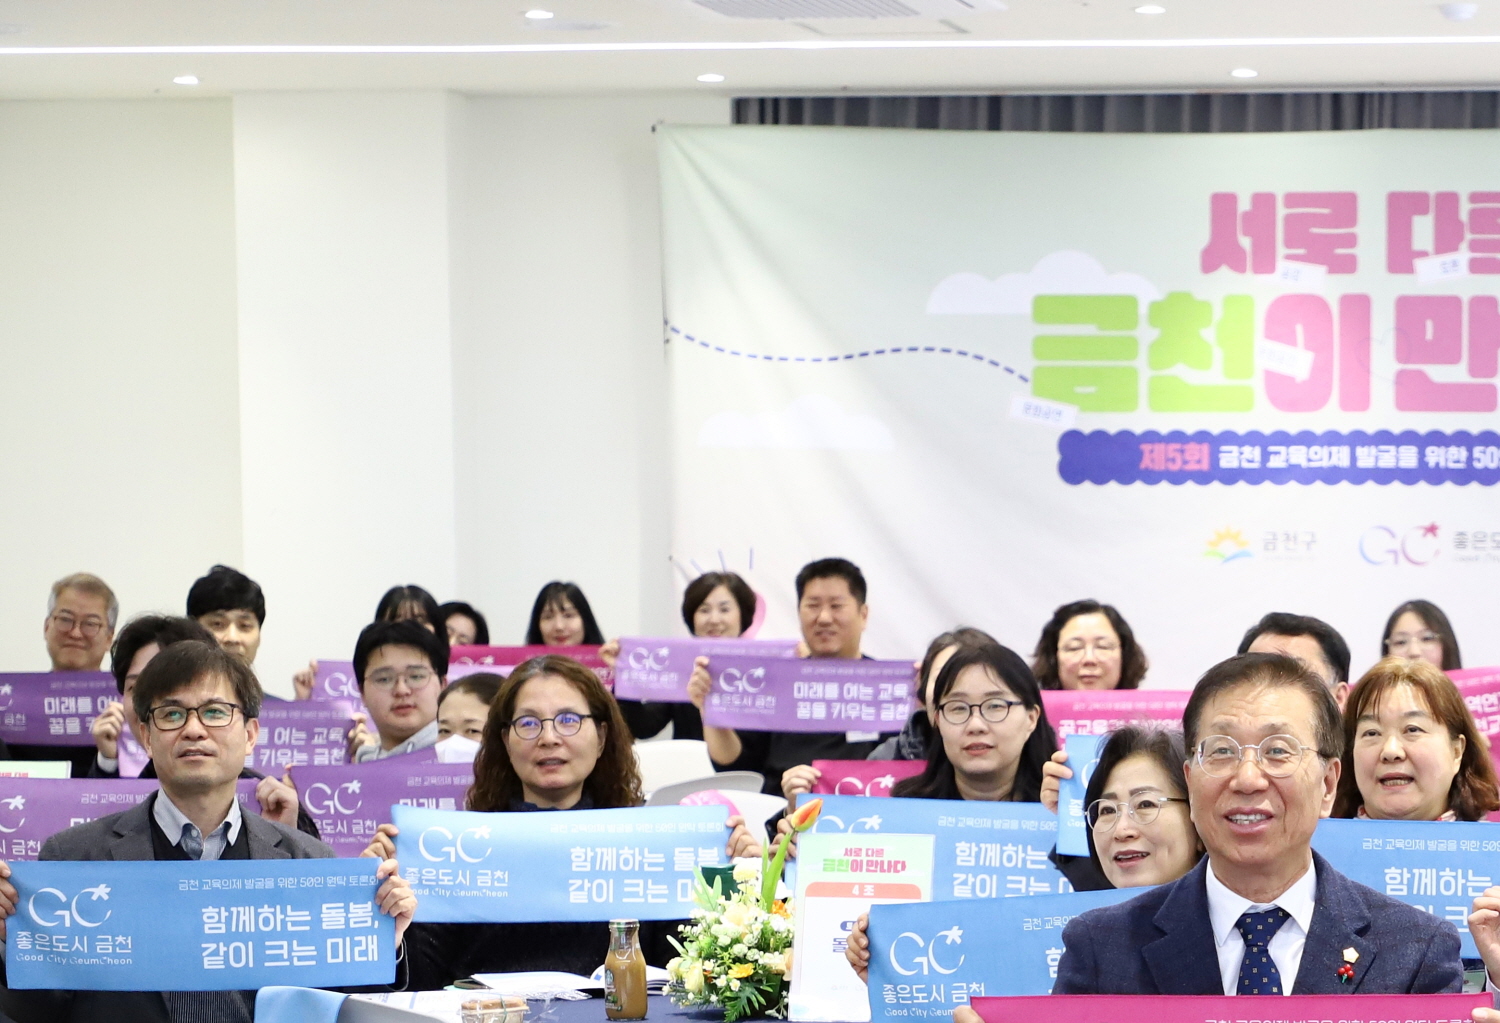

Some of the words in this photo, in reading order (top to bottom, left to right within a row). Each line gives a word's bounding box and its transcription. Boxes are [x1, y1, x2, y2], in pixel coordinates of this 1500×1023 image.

[1201, 192, 1357, 274] 서로
[1031, 291, 1371, 412] 금천이
[1139, 442, 1210, 471] 제5회
[1218, 446, 1261, 468] 금천
[1266, 446, 1349, 468] 교육의제
[1356, 446, 1418, 469] 발굴을
[1424, 446, 1468, 469] 위한
[1262, 531, 1317, 551] 금천구
[1359, 522, 1441, 566] GC
[794, 682, 839, 699] 미래를
[843, 683, 874, 700] 여는
[44, 697, 92, 714] 미래를
[796, 703, 827, 719] 꿈을
[832, 703, 875, 720] 키우는
[880, 703, 909, 720] 금천
[49, 717, 81, 735] 꿈을
[275, 728, 306, 745] 여는
[260, 749, 307, 765] 키우는
[313, 749, 345, 765] 금천
[305, 780, 362, 815] GC
[570, 847, 665, 871] 함께하는
[844, 848, 862, 857] 서로
[866, 848, 884, 857] 다른
[956, 842, 1048, 868] 함께하는
[823, 858, 863, 872] 금천이
[866, 859, 906, 873] 만나다
[179, 880, 199, 891] 금천
[202, 879, 242, 891] 교육의제
[245, 878, 274, 890] 발굴을
[277, 878, 297, 889] 위한
[300, 877, 323, 889] 50인
[326, 876, 346, 888] 원탁
[349, 874, 379, 887] 토론회
[568, 878, 613, 903] 같이
[622, 878, 668, 902] 크는
[852, 885, 859, 895] 4
[864, 885, 874, 896] 조
[952, 874, 996, 898] 같이
[1384, 867, 1492, 896] 함께하는
[29, 884, 112, 928] GC
[202, 903, 311, 934] 함께하는
[321, 901, 378, 929] 돌봄,
[16, 932, 88, 953] 좋은도시
[96, 935, 132, 953] 금천
[201, 942, 253, 970] 같이
[264, 940, 317, 966] 크는
[326, 935, 378, 963] 미래
[890, 926, 964, 976] GC
